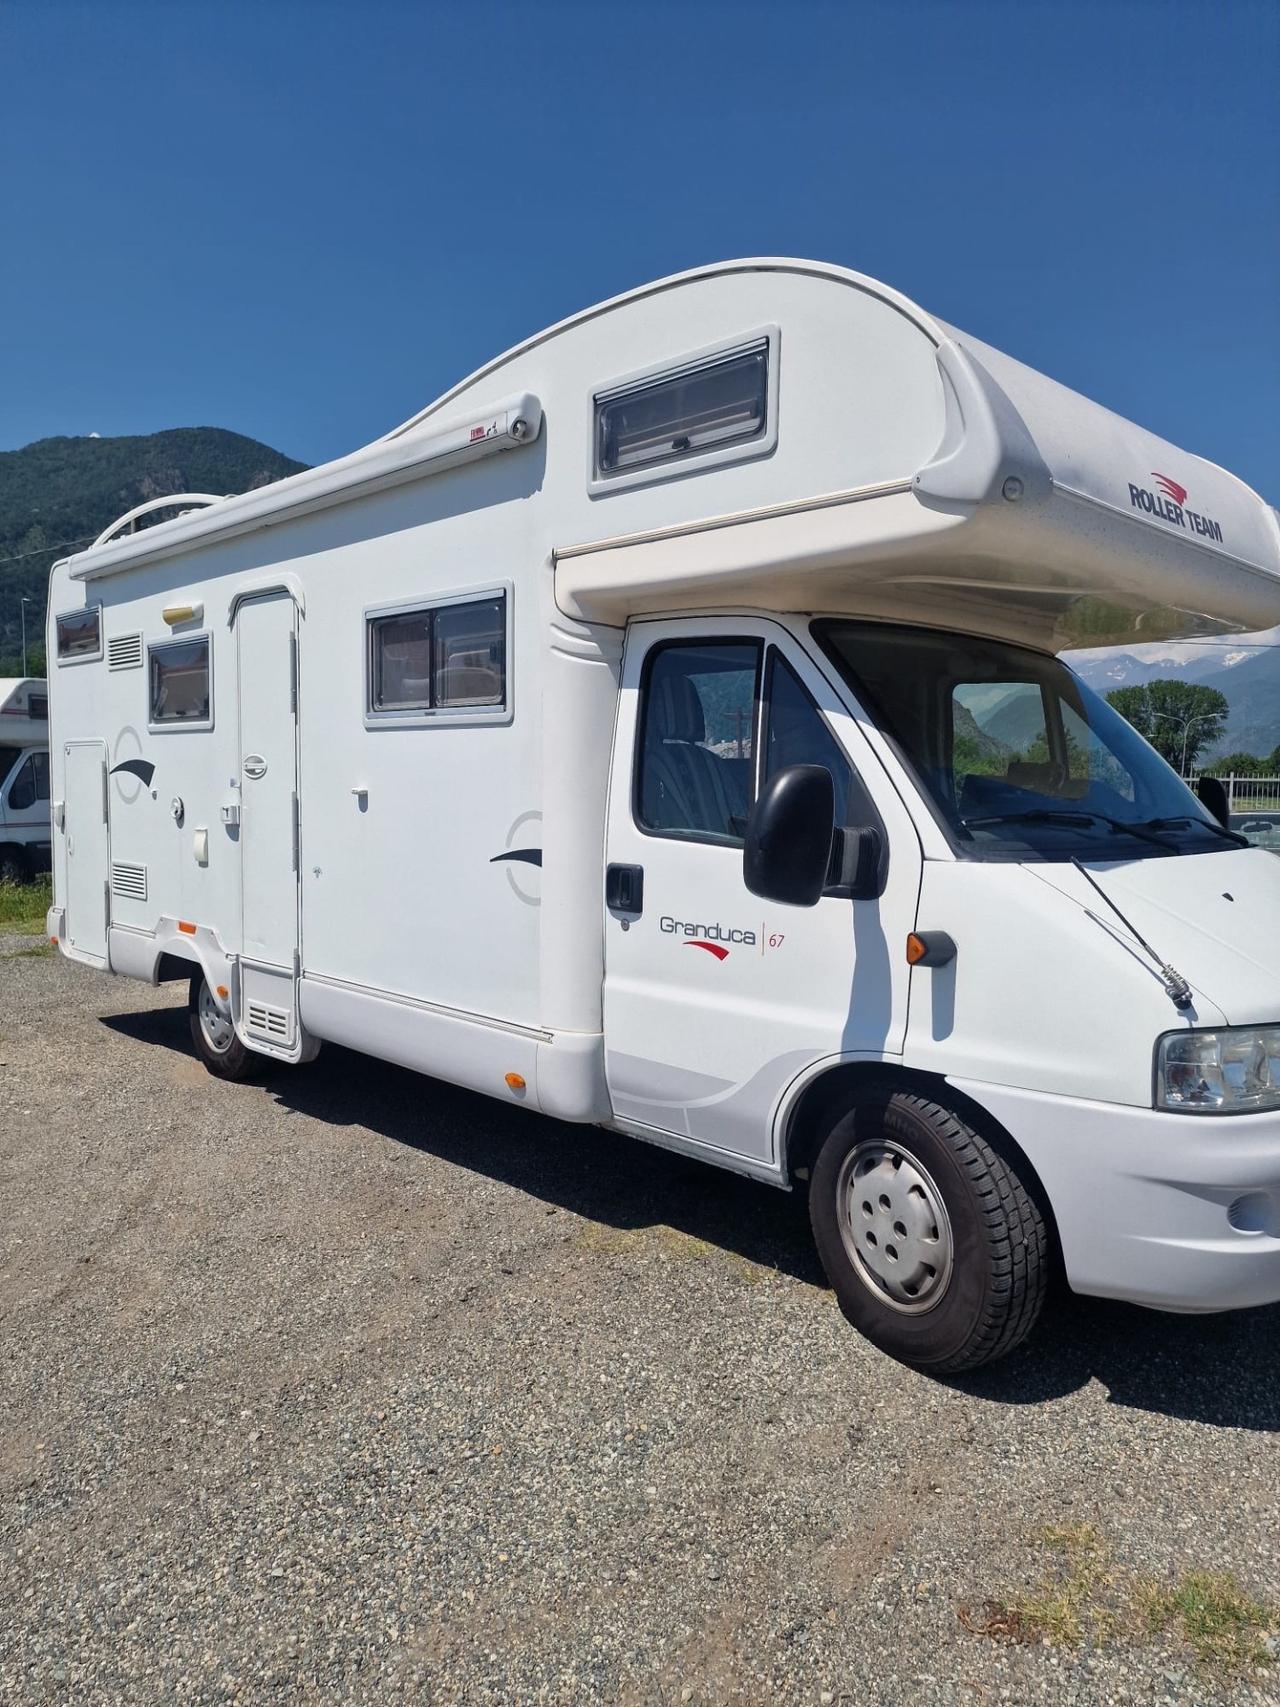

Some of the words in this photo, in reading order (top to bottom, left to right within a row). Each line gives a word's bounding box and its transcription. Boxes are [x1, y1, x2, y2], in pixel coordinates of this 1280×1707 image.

[1128, 482, 1187, 528] ROLLER
[1185, 509, 1224, 543] TEAM
[660, 916, 756, 946] Granduca
[769, 934, 785, 949] 67
